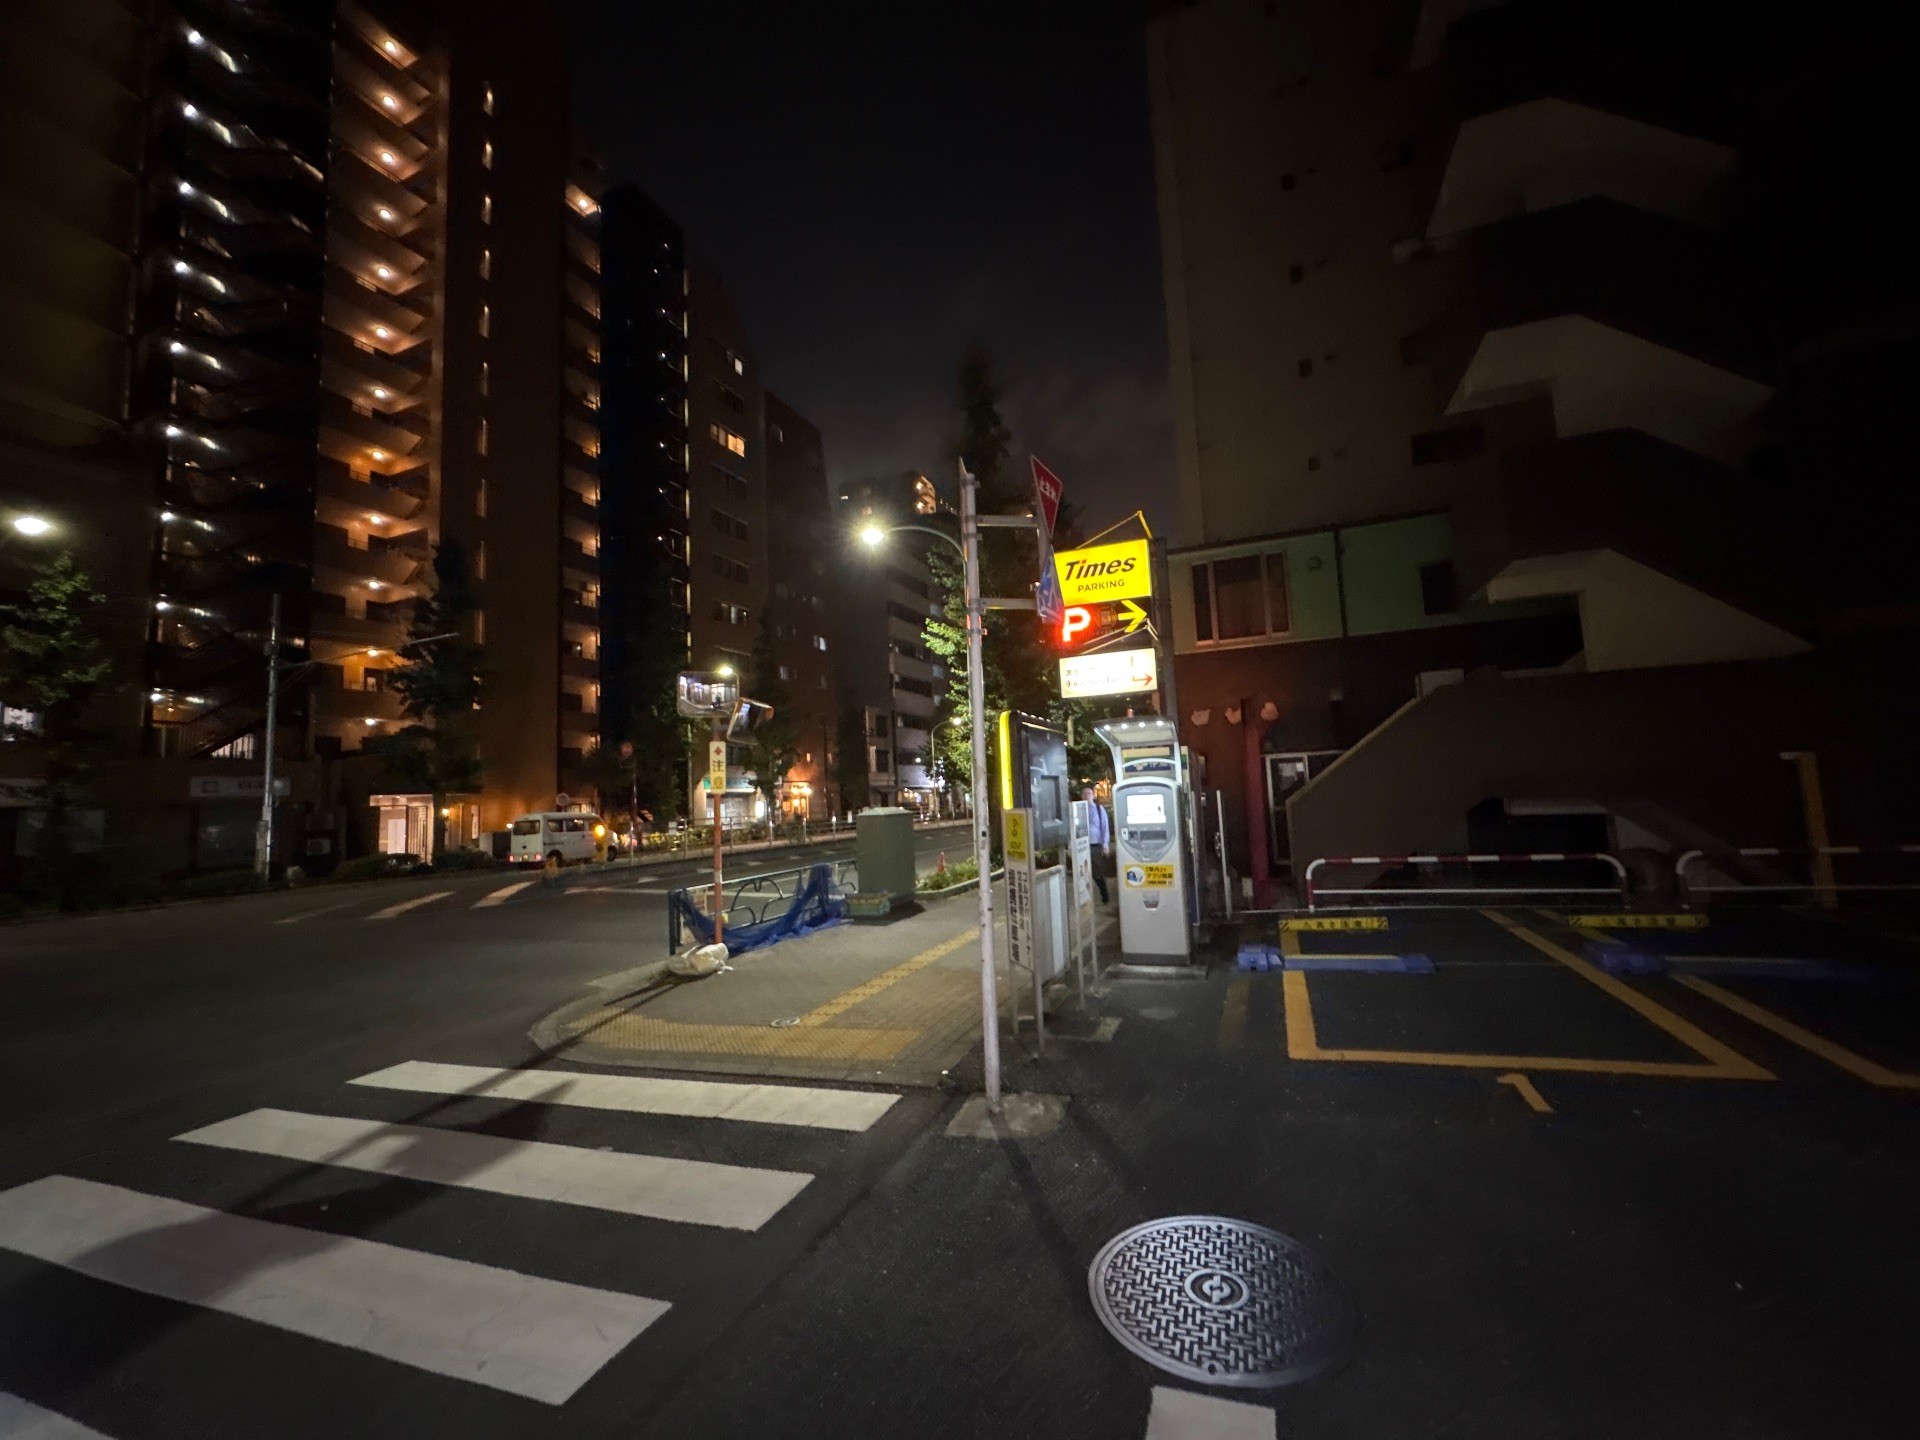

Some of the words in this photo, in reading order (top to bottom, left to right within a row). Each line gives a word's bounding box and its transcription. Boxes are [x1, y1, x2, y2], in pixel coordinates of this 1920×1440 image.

[1065, 557, 1136, 581] Times
[1077, 578, 1125, 593] PARKING
[1062, 607, 1090, 642] P
[712, 759, 724, 789] 注意
